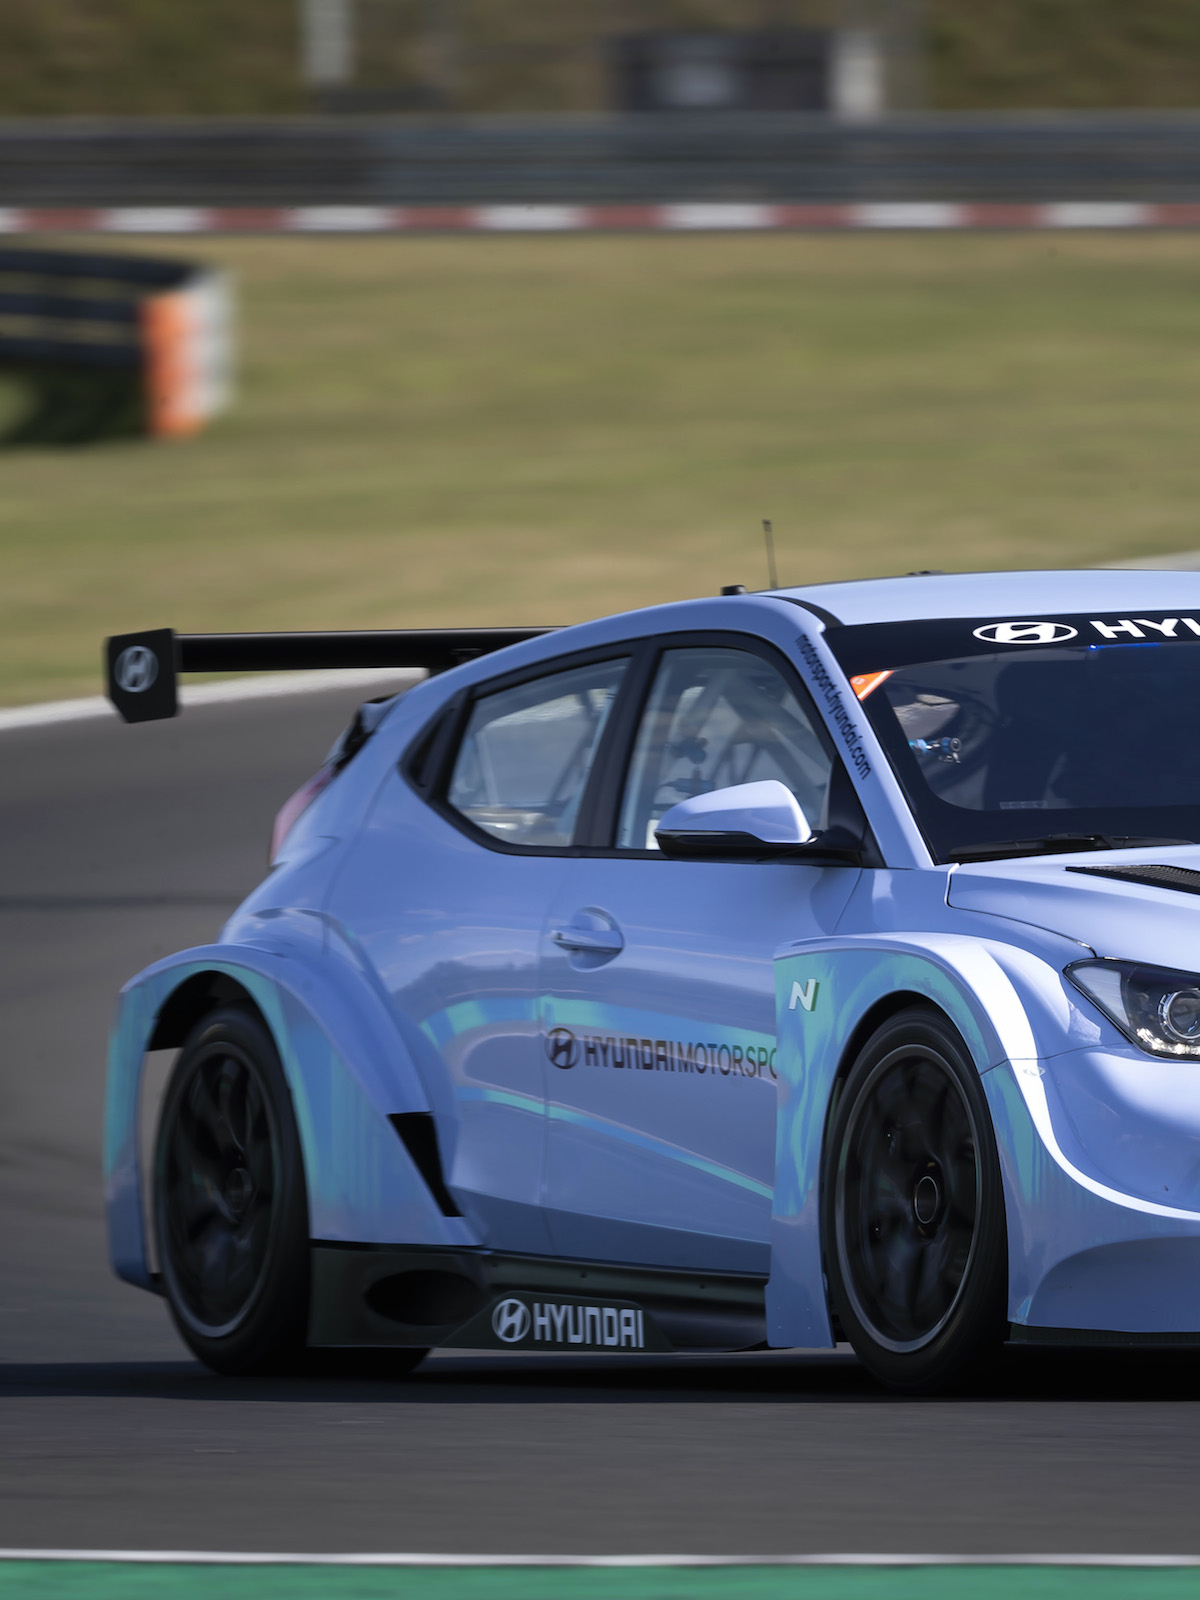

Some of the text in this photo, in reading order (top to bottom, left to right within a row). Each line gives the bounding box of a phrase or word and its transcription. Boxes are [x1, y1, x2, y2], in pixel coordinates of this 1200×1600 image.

[795, 633, 873, 780] motorsport.hyundai.com
[788, 978, 820, 1012] N
[533, 1302, 645, 1349] HYUNDAI
